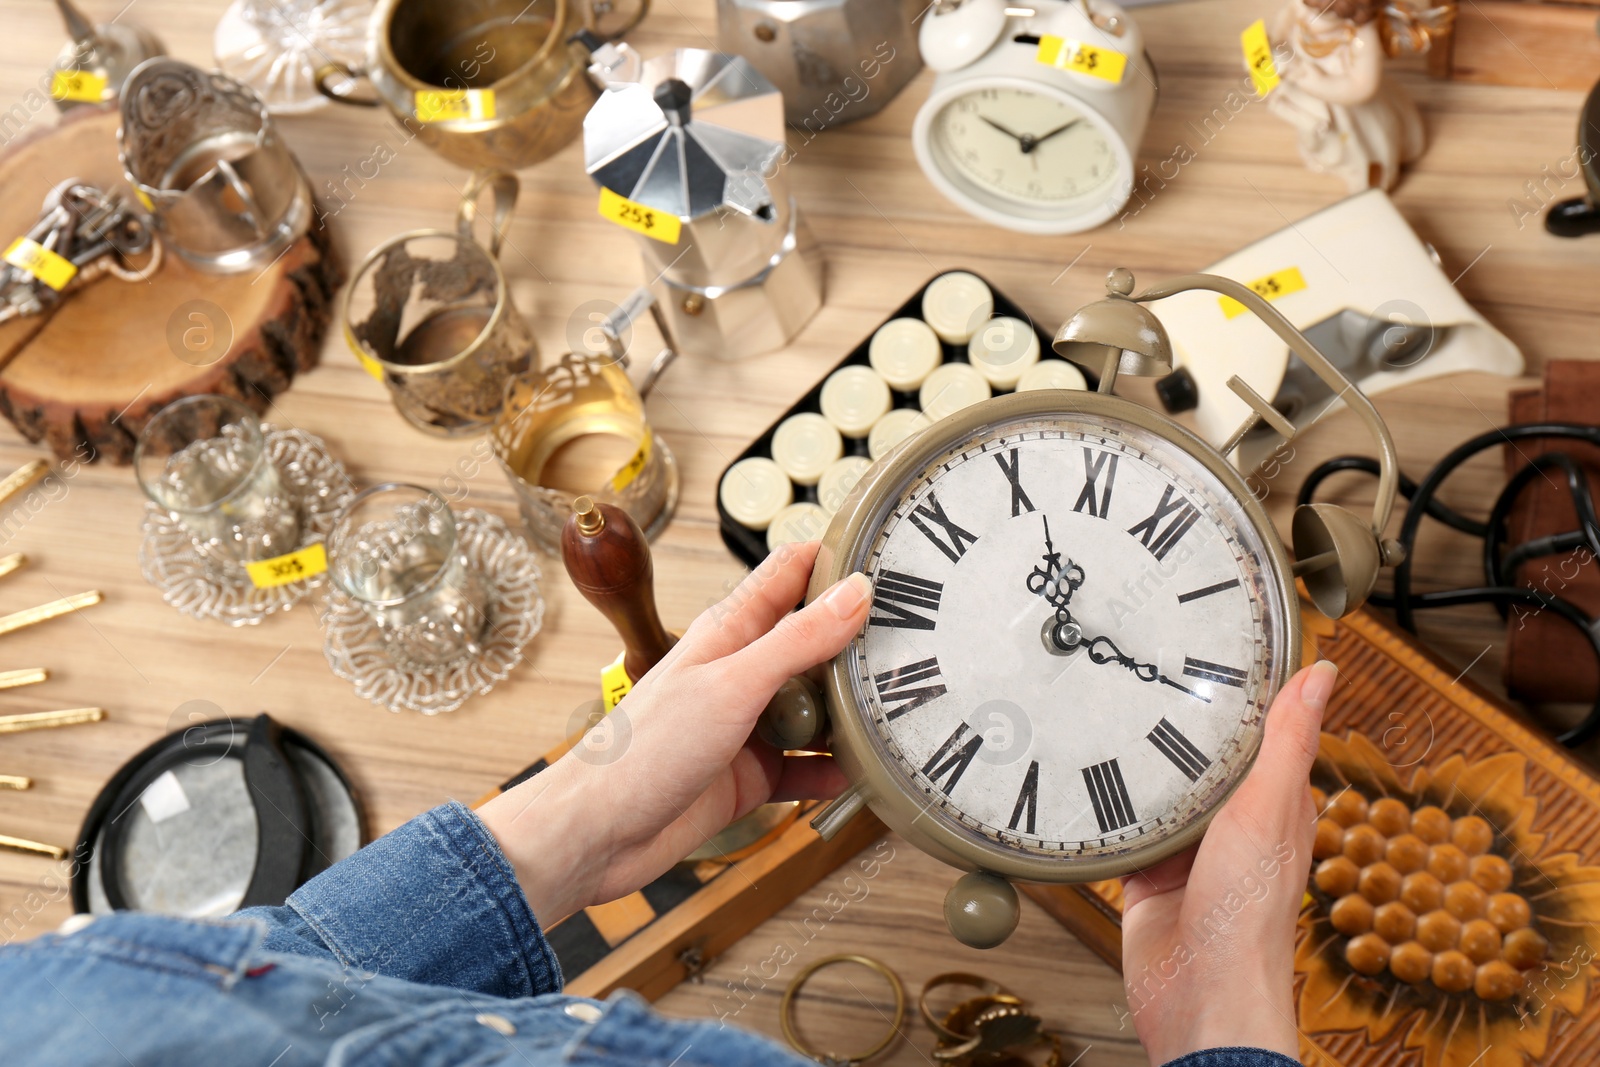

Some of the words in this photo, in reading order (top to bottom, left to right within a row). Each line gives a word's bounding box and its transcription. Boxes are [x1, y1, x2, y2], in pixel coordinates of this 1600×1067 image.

[619, 203, 655, 230] 25$
[993, 447, 1036, 519] X
[1069, 447, 1122, 520] XI
[905, 490, 981, 565] IX
[1124, 482, 1204, 562] XII
[868, 567, 944, 631] VIII
[1177, 577, 1242, 605] I
[874, 655, 948, 724] VII
[1182, 654, 1249, 689] II
[921, 720, 985, 798] VI
[1145, 715, 1213, 784] III
[1008, 759, 1040, 835] V
[1081, 757, 1139, 835] IIII
